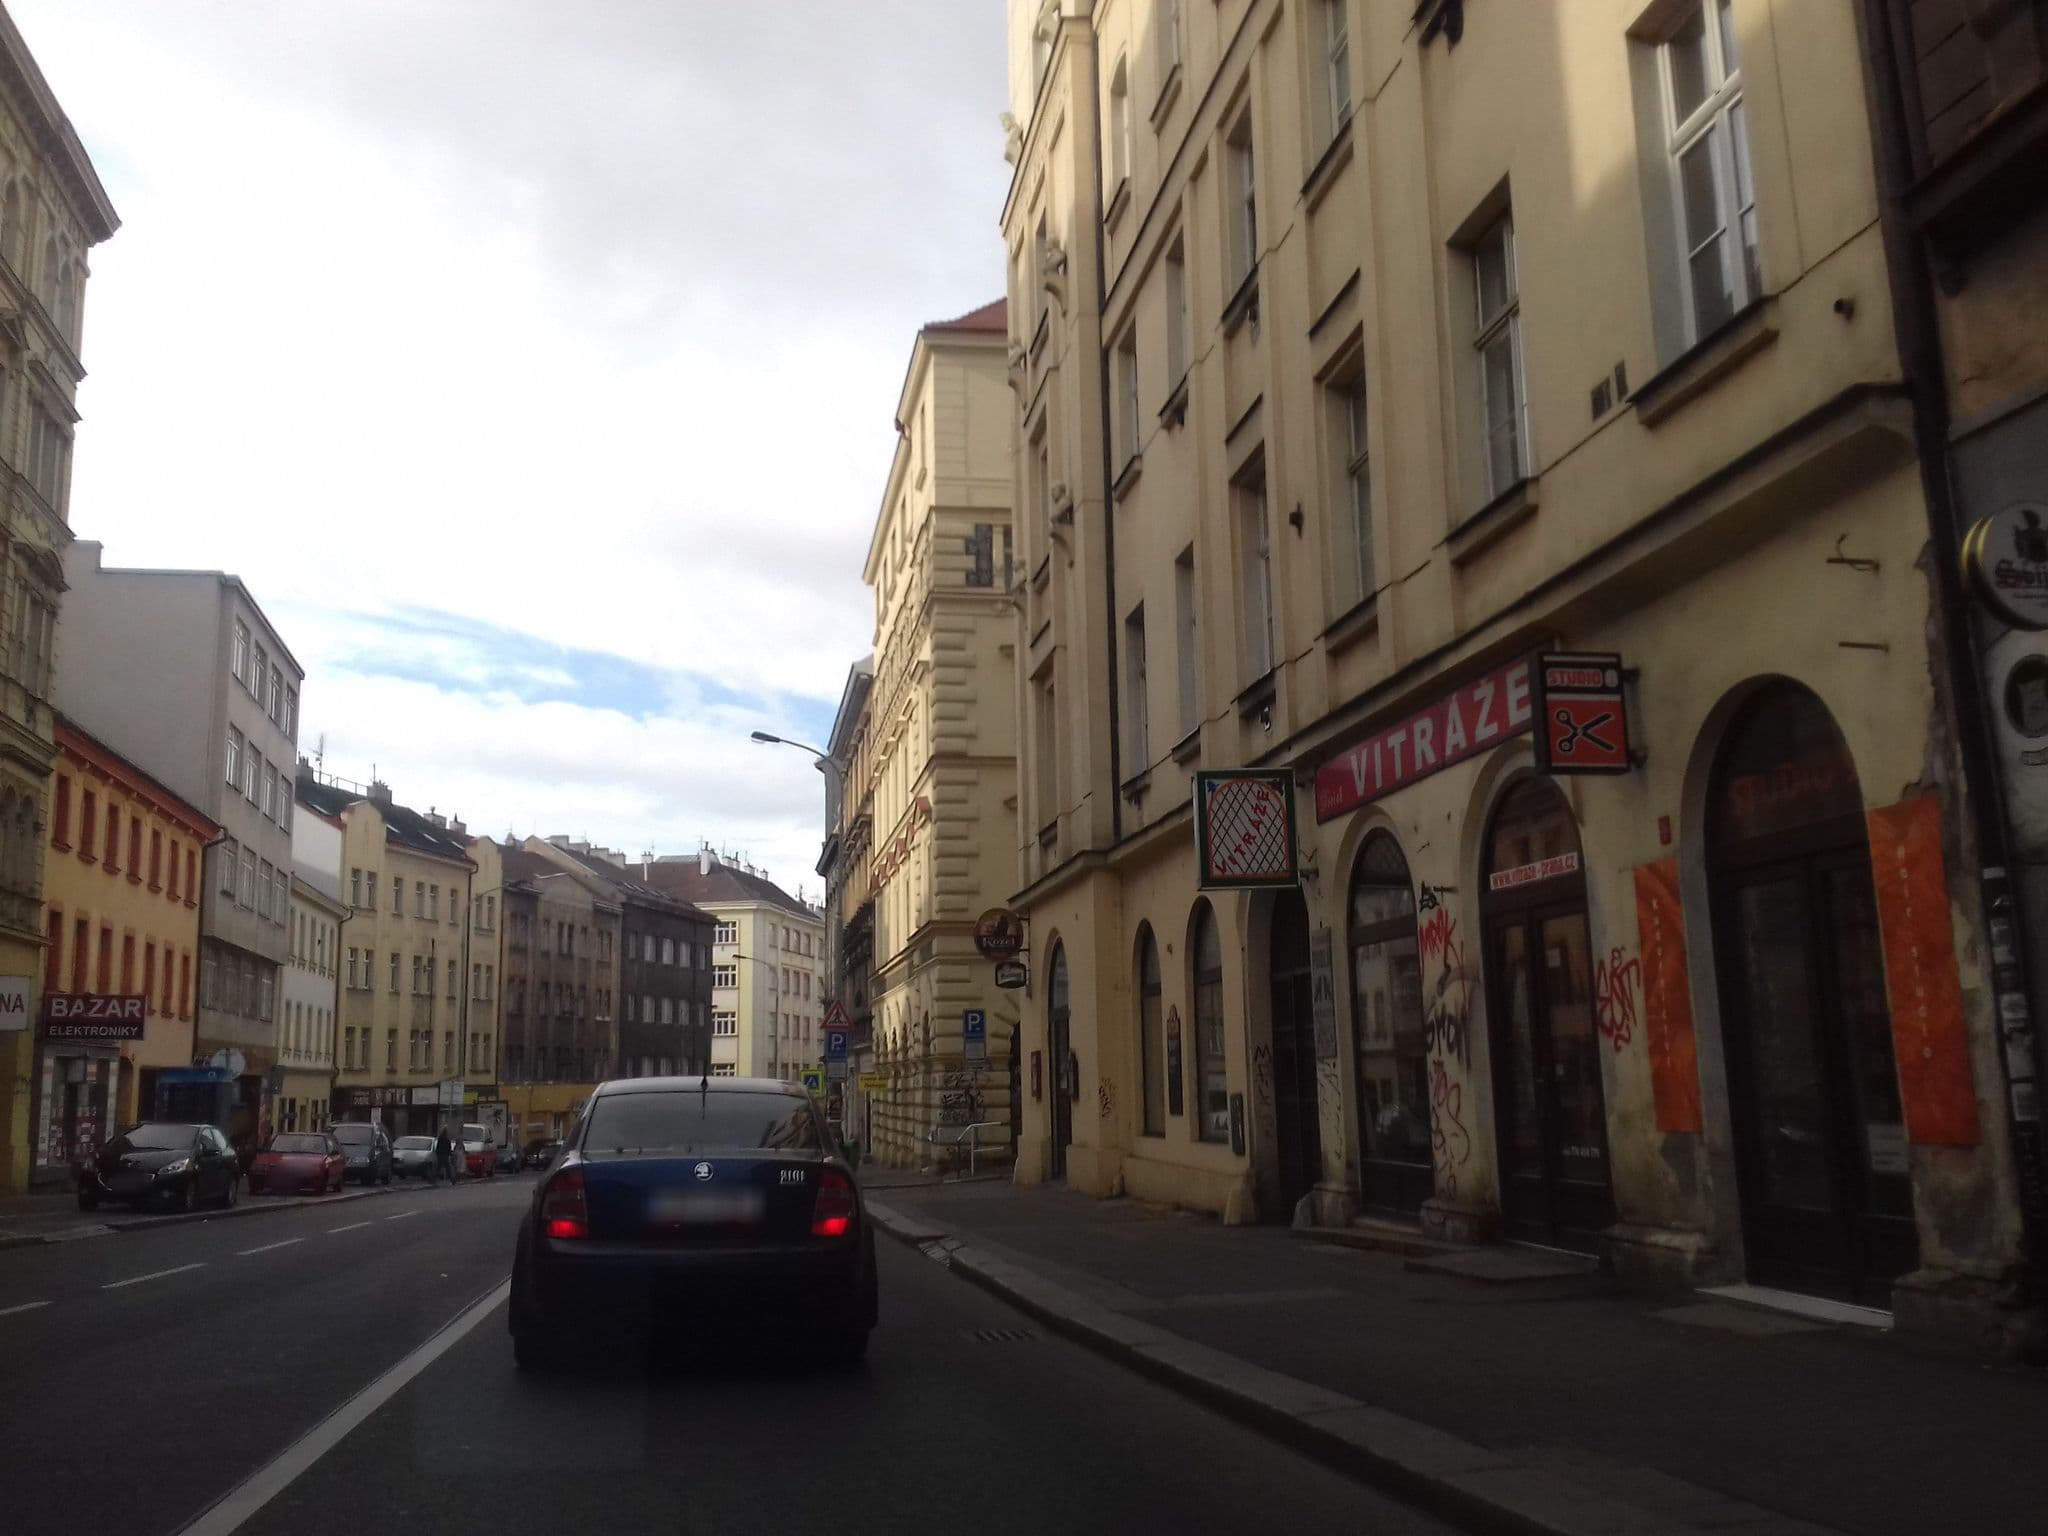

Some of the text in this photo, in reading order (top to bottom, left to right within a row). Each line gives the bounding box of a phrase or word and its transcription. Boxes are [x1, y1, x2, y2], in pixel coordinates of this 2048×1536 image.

[1548, 669, 1602, 687] STUDIO
[1350, 661, 1533, 797] VITRÁŽE
[50, 998, 142, 1018] BAZAR
[49, 1026, 139, 1037] ELEKTRONIKY
